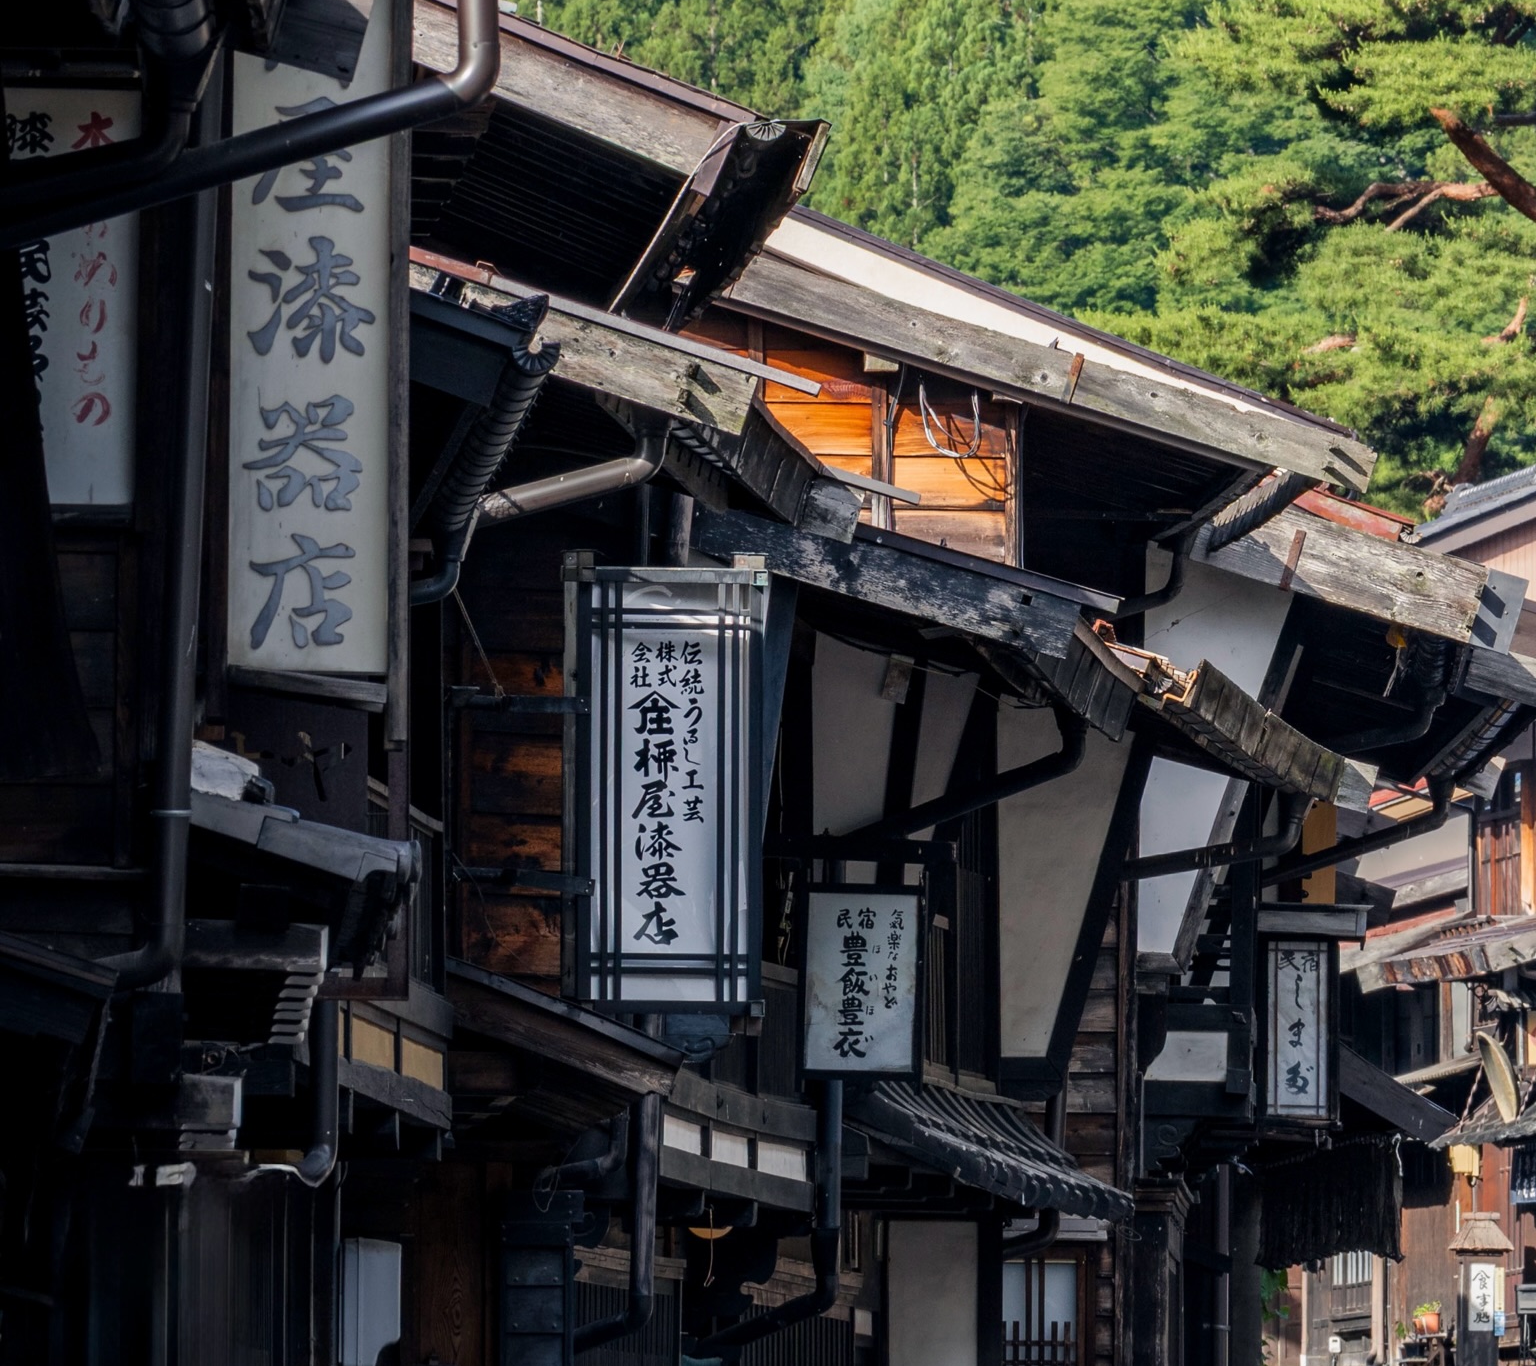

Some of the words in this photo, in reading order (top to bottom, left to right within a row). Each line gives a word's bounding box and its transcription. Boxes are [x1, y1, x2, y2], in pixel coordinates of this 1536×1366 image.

[242, 59, 377, 651] 屋漆器店
[679, 640, 705, 823] 伝統うるし工芸
[836, 907, 877, 930] 民宿
[1278, 950, 1319, 973] 民宿
